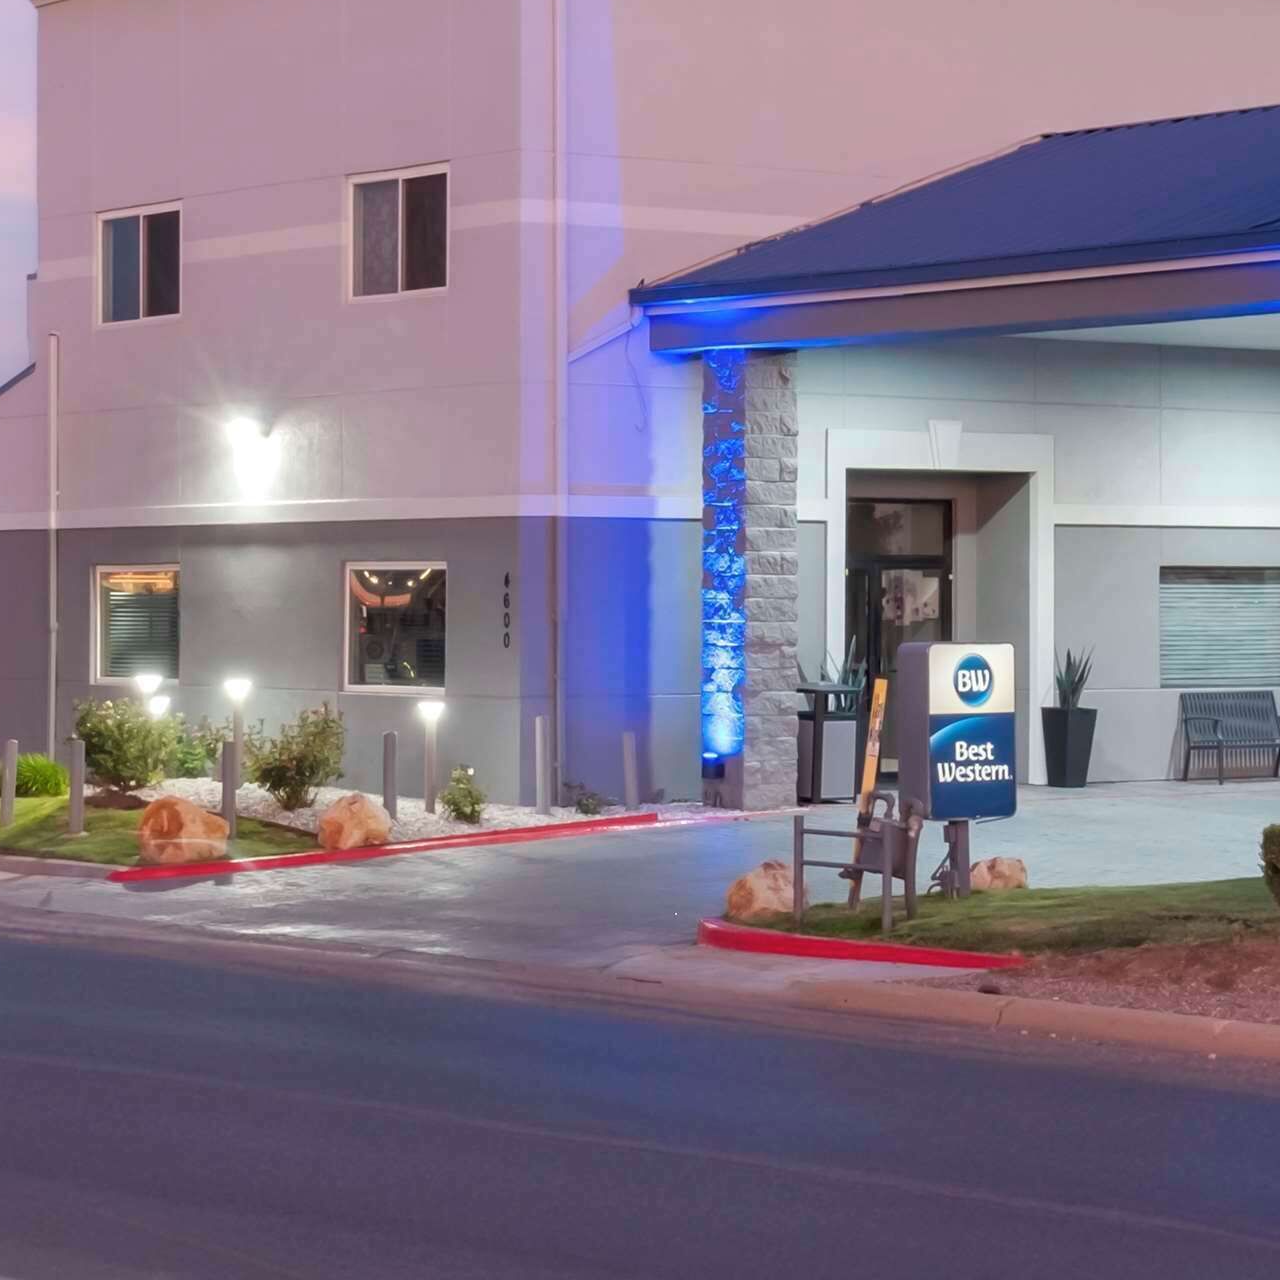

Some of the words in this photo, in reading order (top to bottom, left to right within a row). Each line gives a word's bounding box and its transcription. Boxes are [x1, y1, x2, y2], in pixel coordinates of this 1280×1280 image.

[503, 571, 511, 649] 4600
[957, 669, 990, 692] BW
[954, 741, 995, 761] Best
